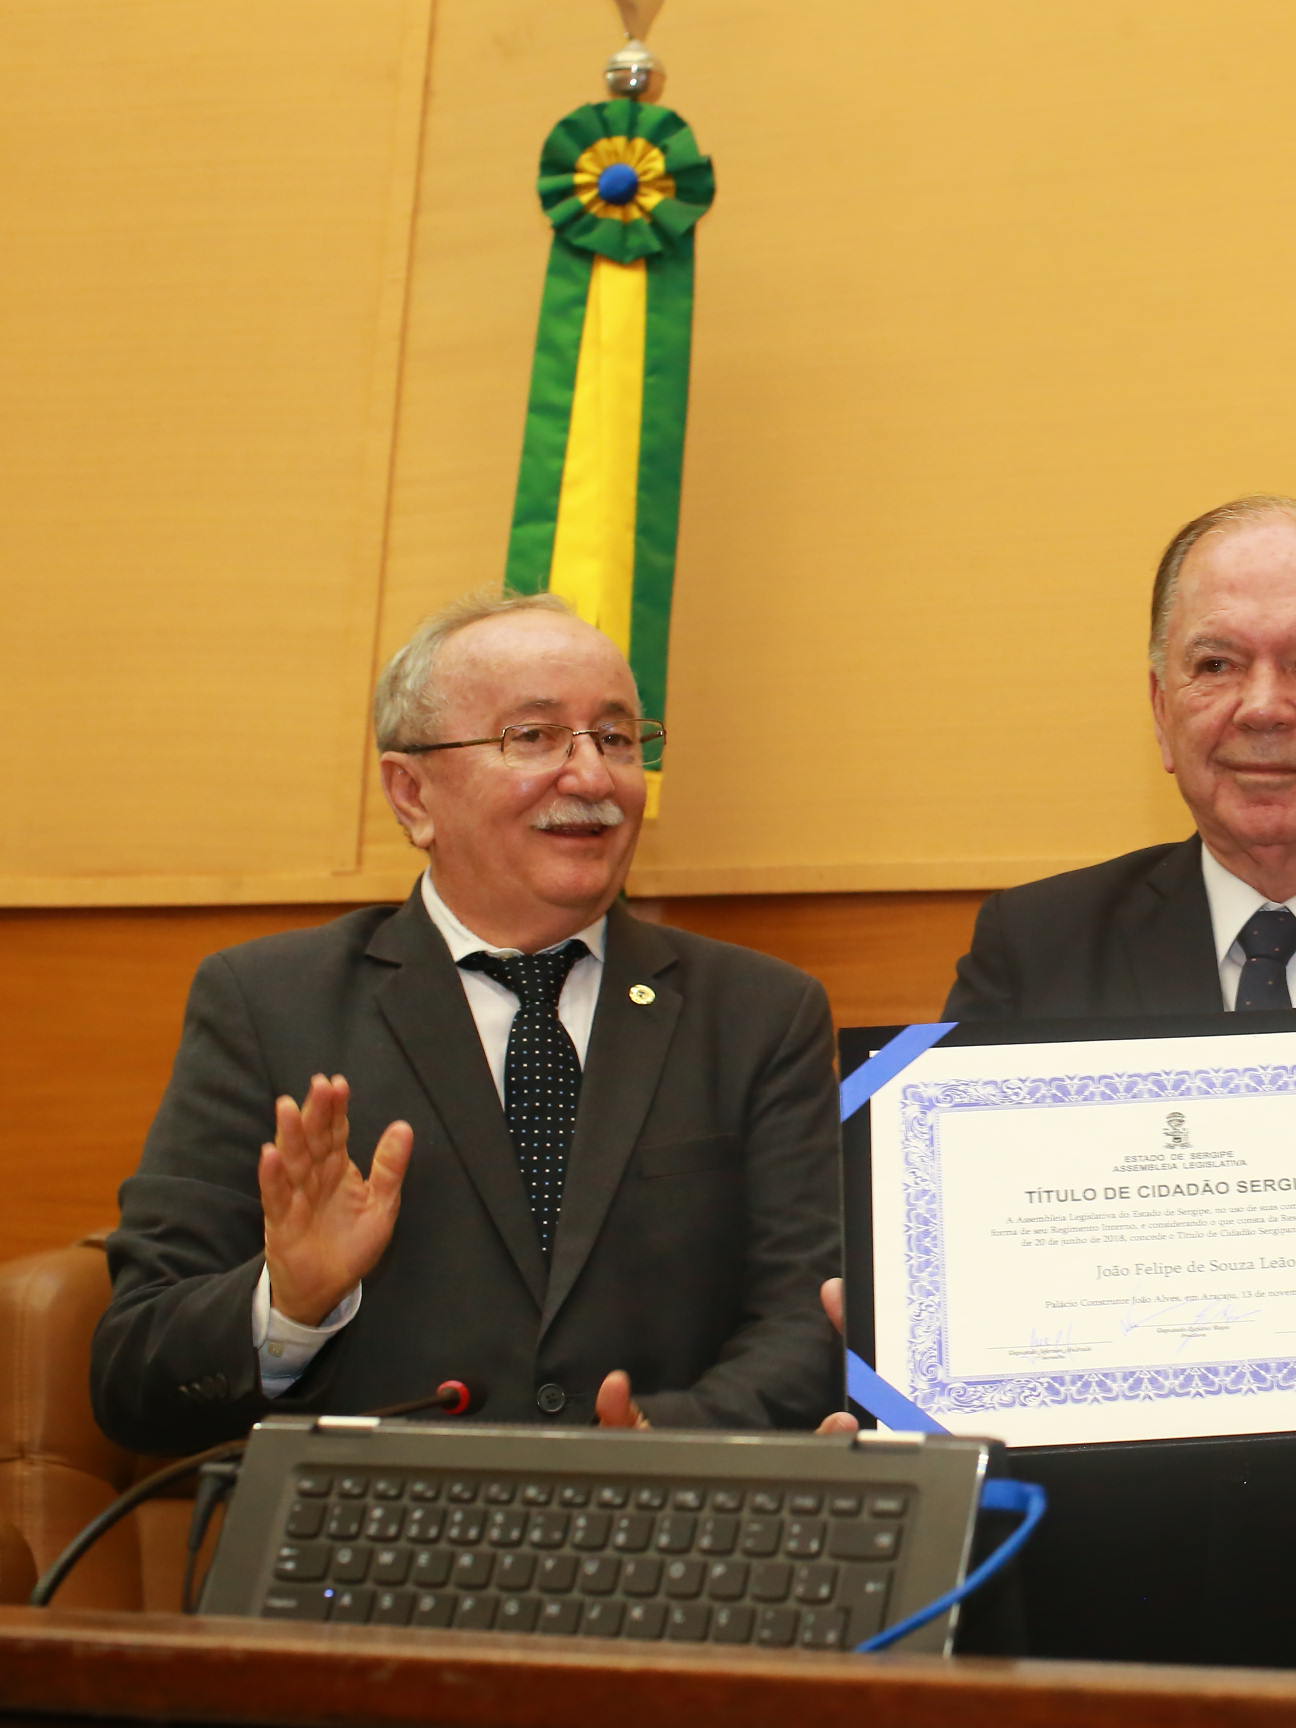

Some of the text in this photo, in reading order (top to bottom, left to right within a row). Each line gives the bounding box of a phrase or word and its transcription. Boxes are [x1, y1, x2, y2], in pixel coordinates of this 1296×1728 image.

[1124, 1154, 1165, 1163] ESTADO
[1190, 1151, 1235, 1159] SERGIPE
[1112, 1160, 1247, 1172] ASSEMBLEIA LEGISLATIVA
[1025, 1187, 1097, 1203] TÍTULO
[1104, 1186, 1131, 1200] DE
[1137, 1180, 1230, 1198] CIDADÃO
[1017, 1214, 1066, 1223] Assembleia
[1069, 1212, 1116, 1222] Legislativa
[1132, 1210, 1161, 1218] Estado
[1051, 1225, 1098, 1235] Regimento
[1096, 1257, 1296, 1280] João Felipe de Souza Leão
[1045, 1299, 1077, 1308] Palácio
